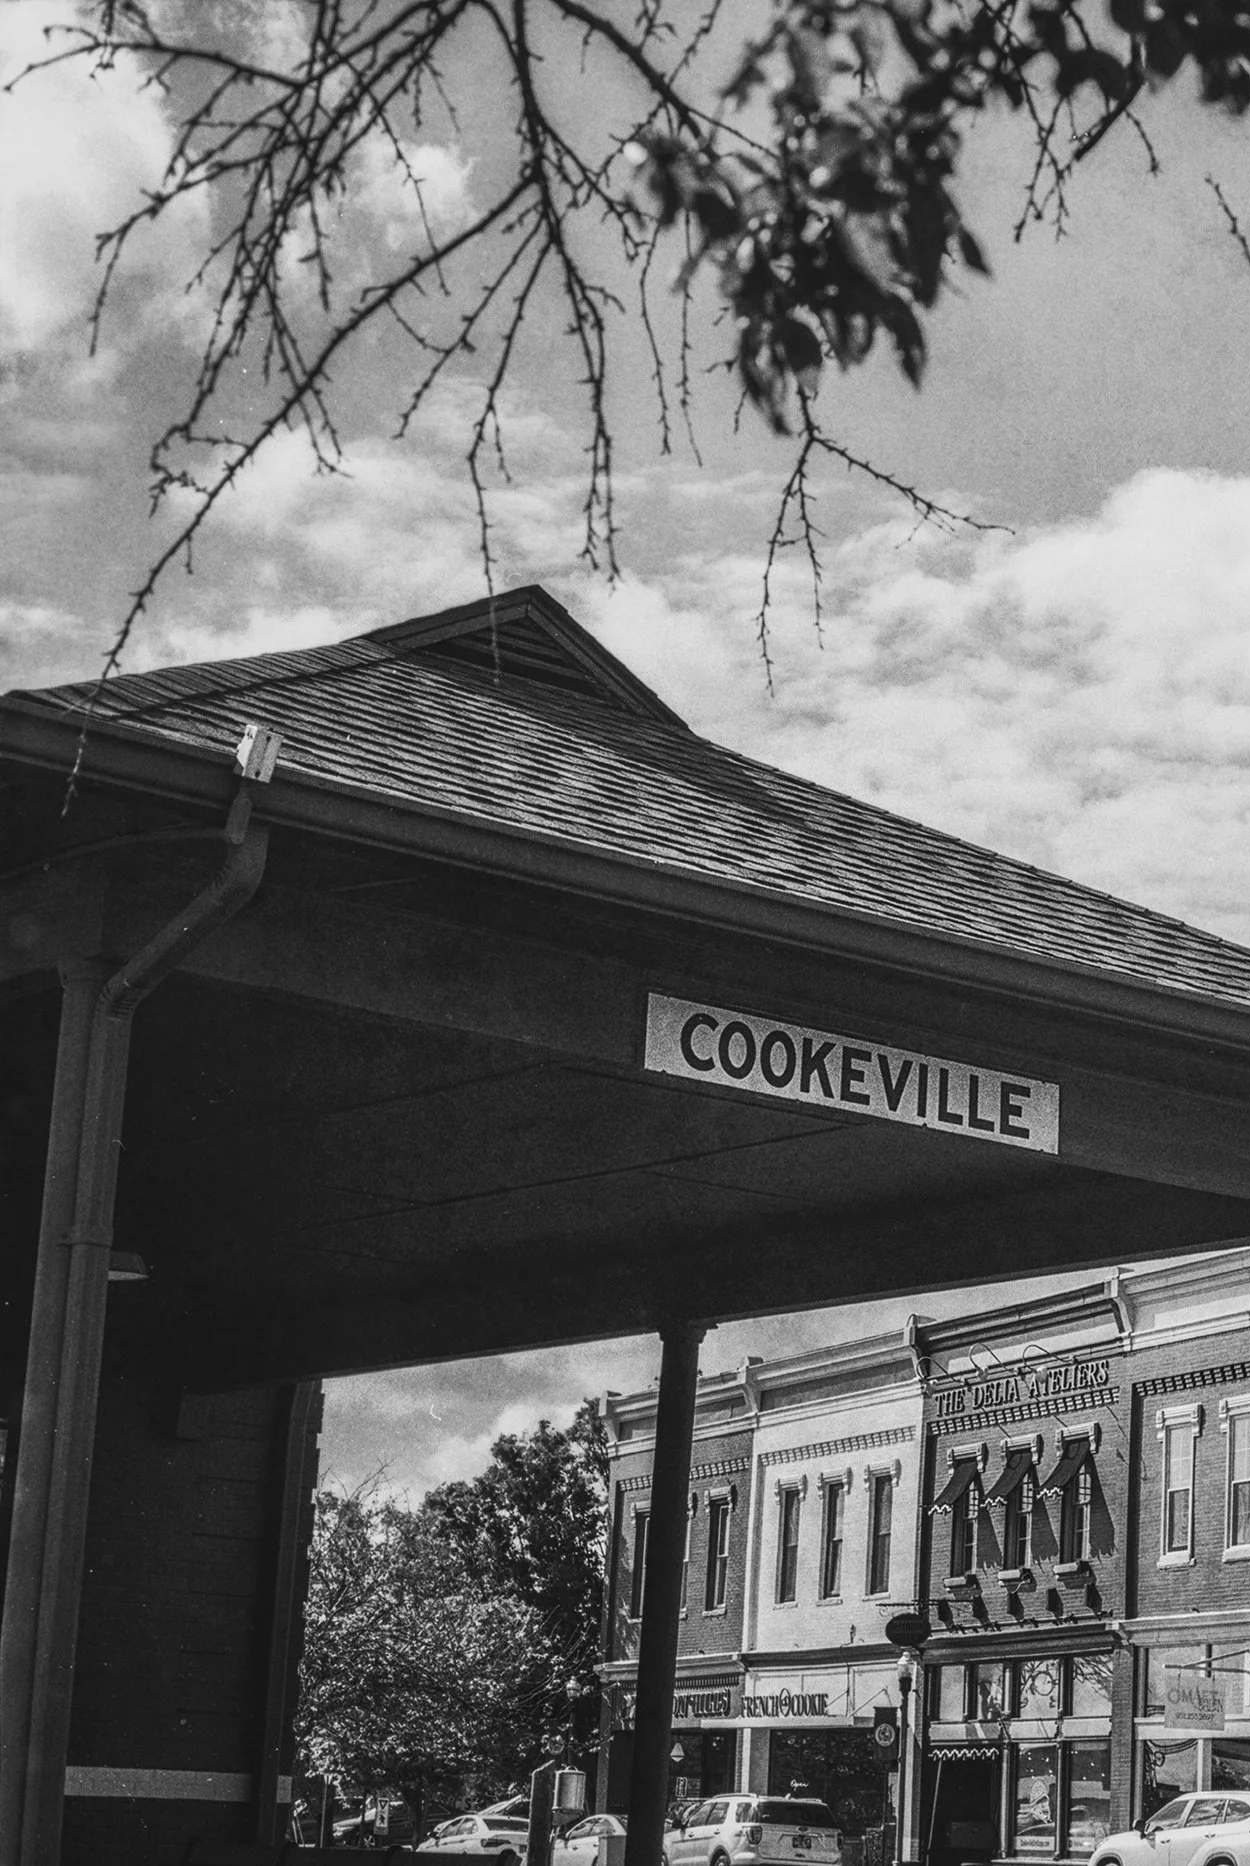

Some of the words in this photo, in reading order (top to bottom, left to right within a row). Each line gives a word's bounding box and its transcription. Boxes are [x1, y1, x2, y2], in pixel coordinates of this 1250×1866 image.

[679, 1012, 1032, 1140] COOKEVILLE
[935, 1388, 966, 1418] THE
[972, 1376, 1021, 1410] DELIA
[790, 1779, 809, 1791] Open
